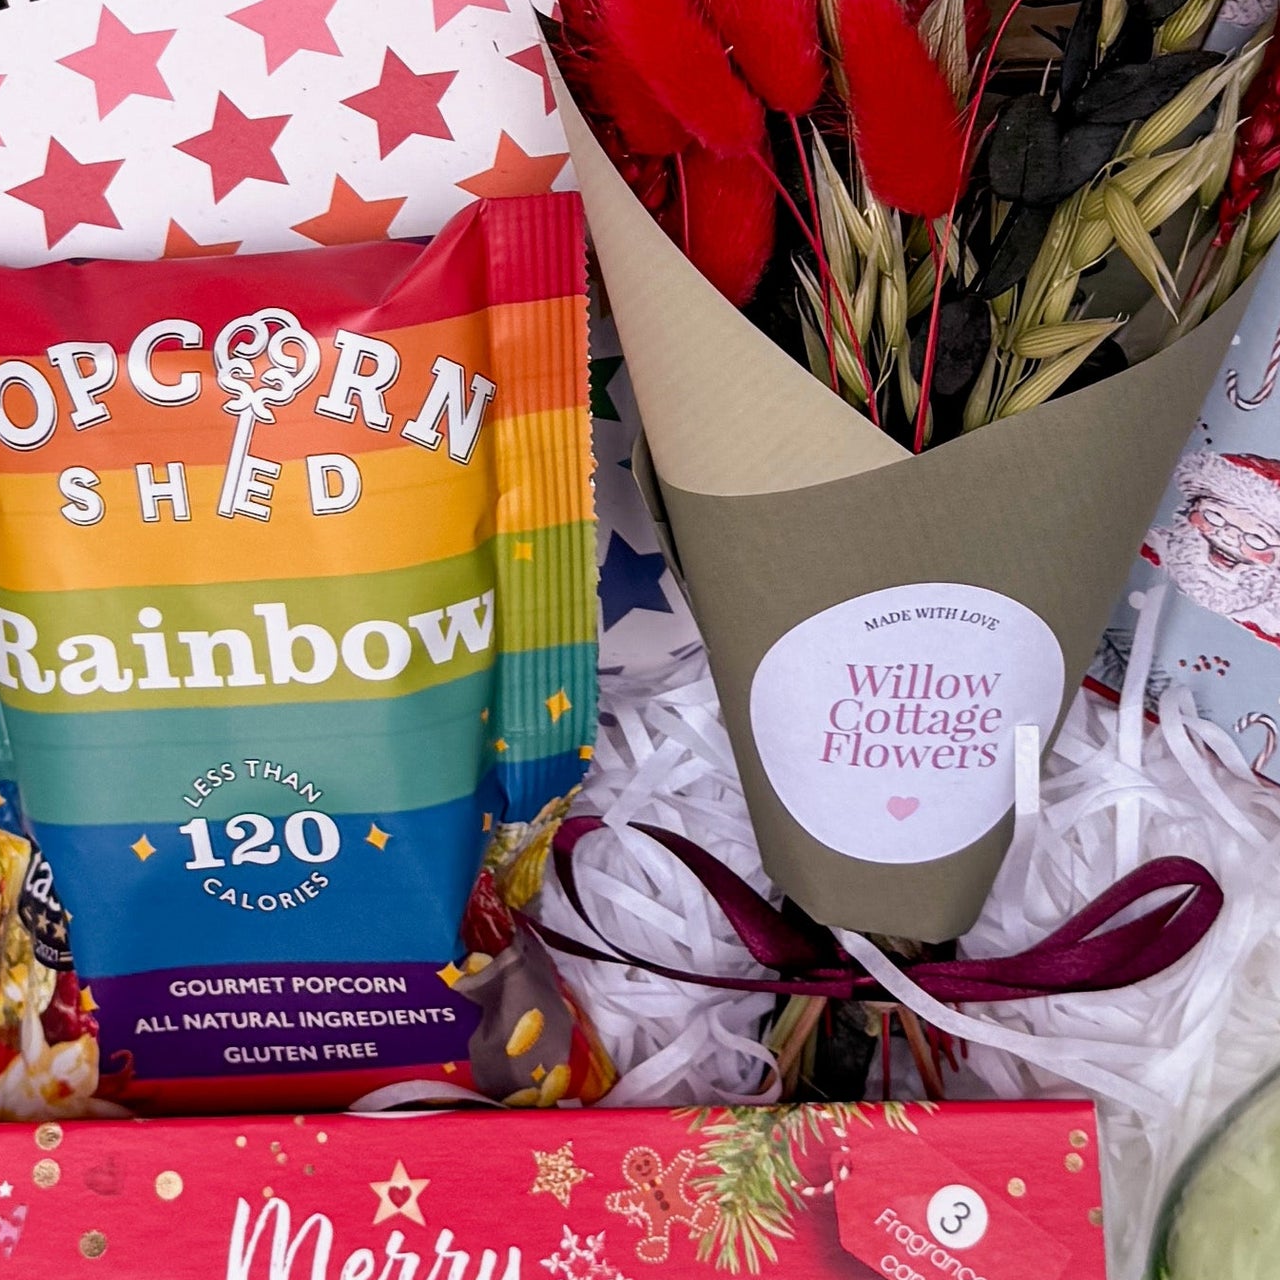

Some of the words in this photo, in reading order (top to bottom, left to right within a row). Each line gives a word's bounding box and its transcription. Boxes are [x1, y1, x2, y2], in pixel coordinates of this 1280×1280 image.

[58, 453, 362, 526] SHED
[863, 609, 912, 632] MADE
[915, 606, 958, 620] WITH
[959, 609, 1001, 632] LOVE
[846, 663, 1002, 700] Willow
[828, 698, 1003, 743] Cottage
[817, 730, 999, 770] Flowers
[183, 763, 236, 808] LESS
[244, 759, 322, 803] THAN
[178, 810, 341, 870] 120
[202, 871, 330, 912] CALORIES
[169, 977, 285, 997] GOURMET
[292, 976, 408, 994] POPCORN
[134, 1014, 179, 1035] ALL
[183, 1010, 294, 1030] NATURAL
[299, 1006, 457, 1028] INGREDIENTS
[223, 1044, 318, 1064] GLUTEN
[323, 1042, 379, 1060] FREE
[939, 1201, 971, 1235] 3
